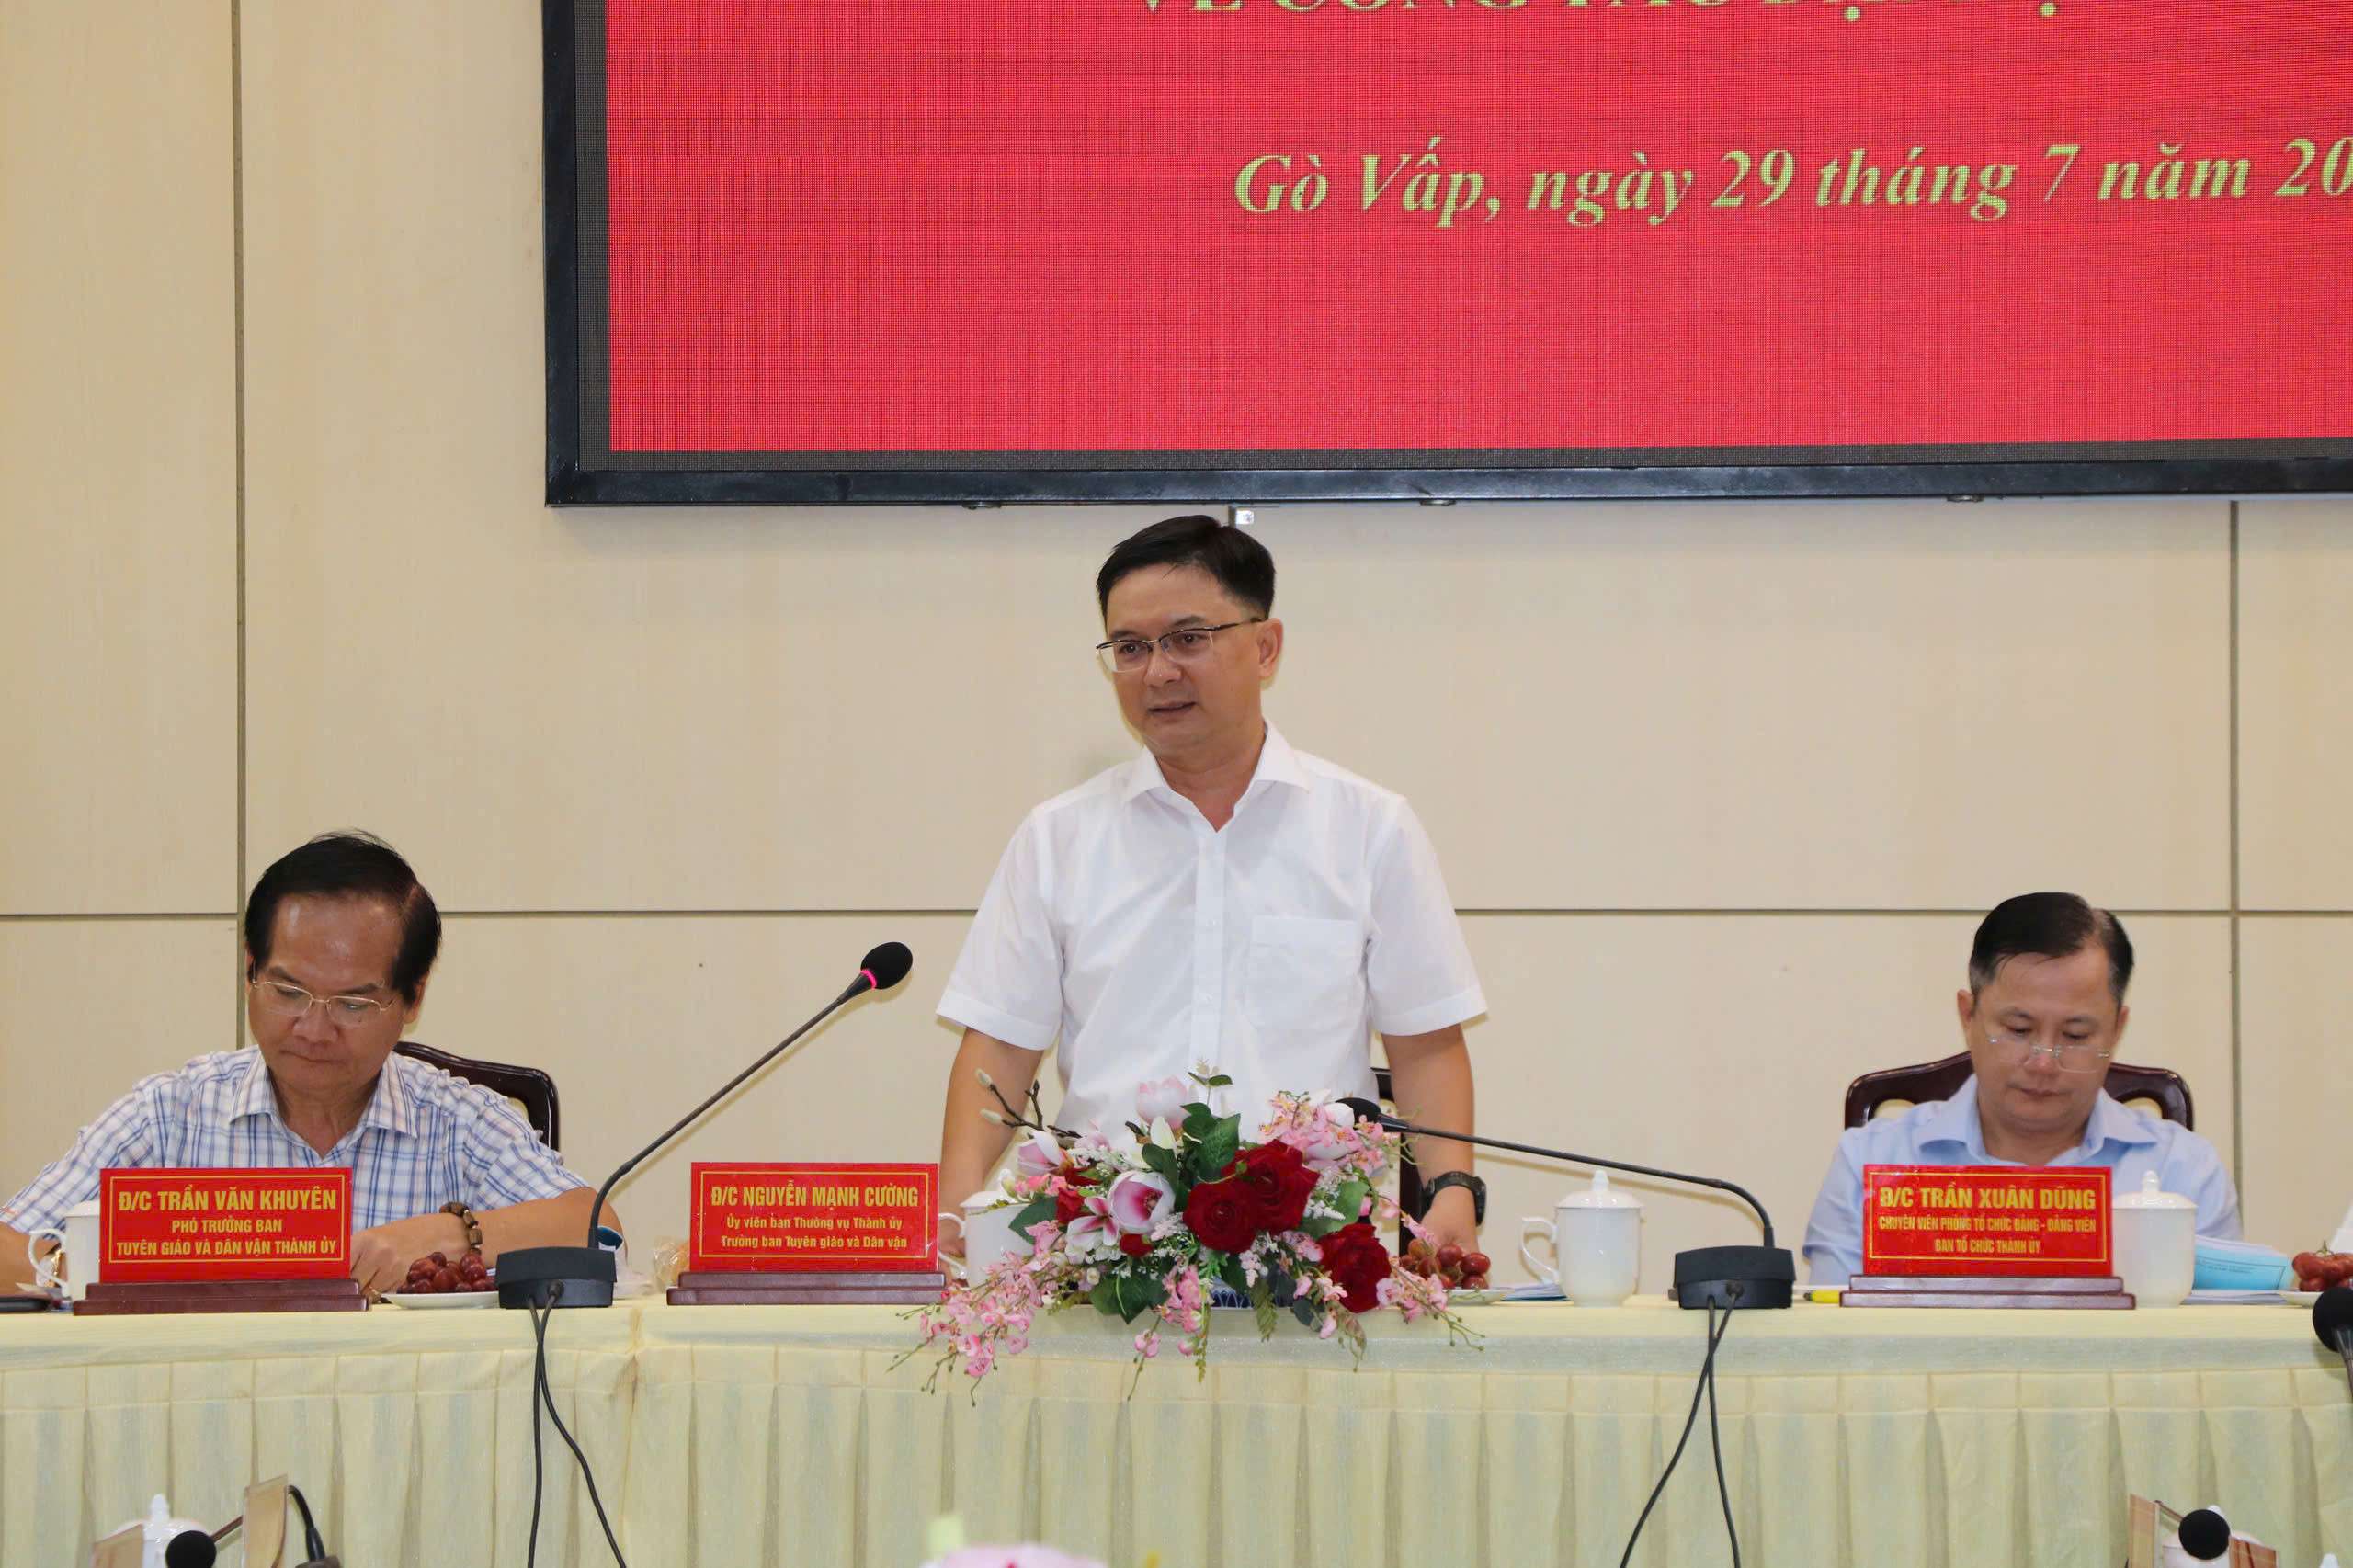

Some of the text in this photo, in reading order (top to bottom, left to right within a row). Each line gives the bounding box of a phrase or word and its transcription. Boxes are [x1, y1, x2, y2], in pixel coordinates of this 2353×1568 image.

[1234, 136, 2353, 229] Gò Vấp, ngày 29 tháng 7 năm 20
[119, 1184, 336, 1211] Đ/C TRẦN VĂN KHUYÊN
[711, 1179, 918, 1211] Đ/C NGUYỄN MẠNH CƯỜNG
[1880, 1181, 2096, 1209] Đ/C TRẦN XUÂN DŨNG
[256, 1219, 282, 1233] BAN
[744, 1216, 767, 1229] viên
[770, 1216, 790, 1229] ban
[836, 1219, 850, 1232] vụ
[853, 1216, 886, 1229] Thành
[117, 1239, 157, 1256] TUYÊN
[161, 1238, 191, 1255] GIÁO
[214, 1238, 242, 1255] DÂN
[245, 1237, 271, 1257] VẬN
[761, 1235, 782, 1247] ban
[785, 1235, 817, 1248] Tuyên
[820, 1235, 844, 1249] giáo
[847, 1235, 860, 1248] và
[863, 1235, 884, 1248] Dân
[888, 1235, 907, 1250] vận
[1935, 1238, 1953, 1252] BAN
